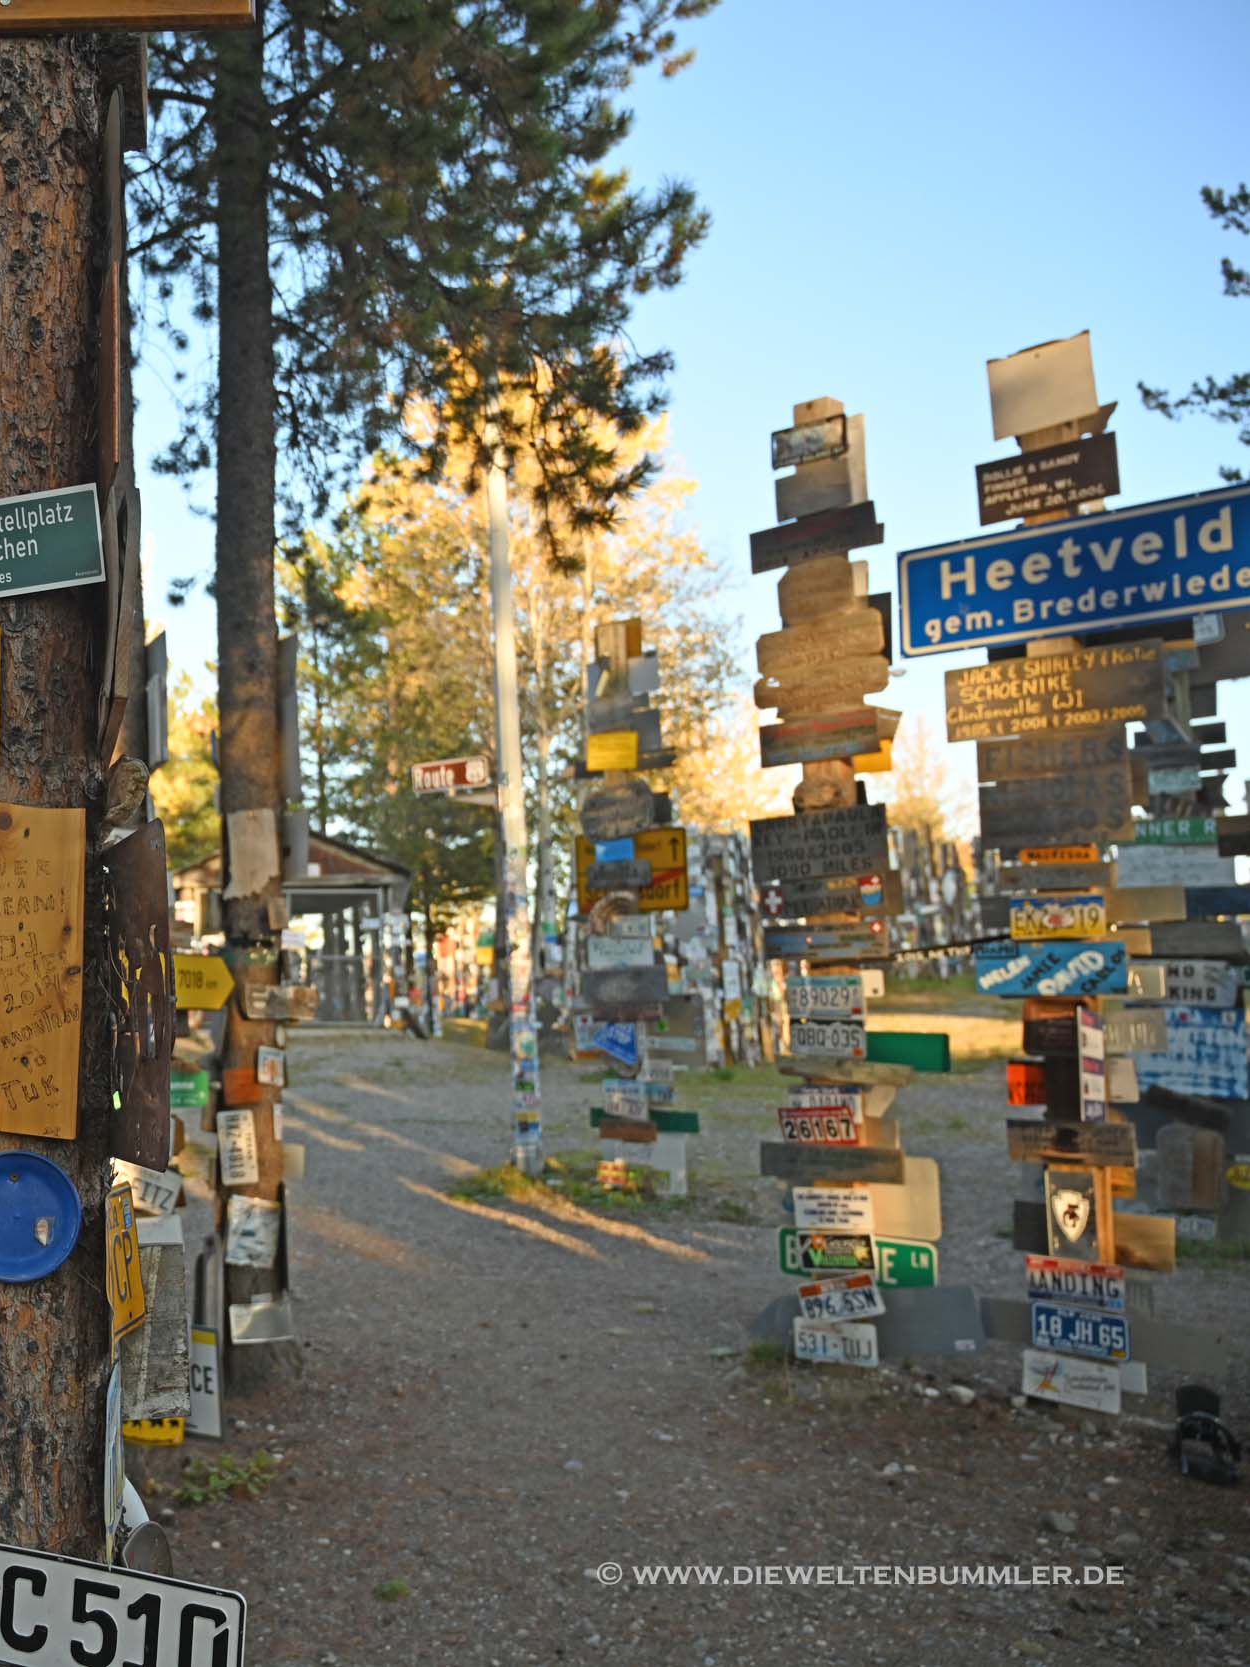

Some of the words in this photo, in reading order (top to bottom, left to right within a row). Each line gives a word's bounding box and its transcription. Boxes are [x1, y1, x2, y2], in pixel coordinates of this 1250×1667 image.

[939, 504, 1234, 600] Heetveld
[924, 610, 1005, 643] gem.
[957, 666, 1003, 687] JACK
[784, 1119, 851, 1139] 26167
[910, 1252, 929, 1269] LN
